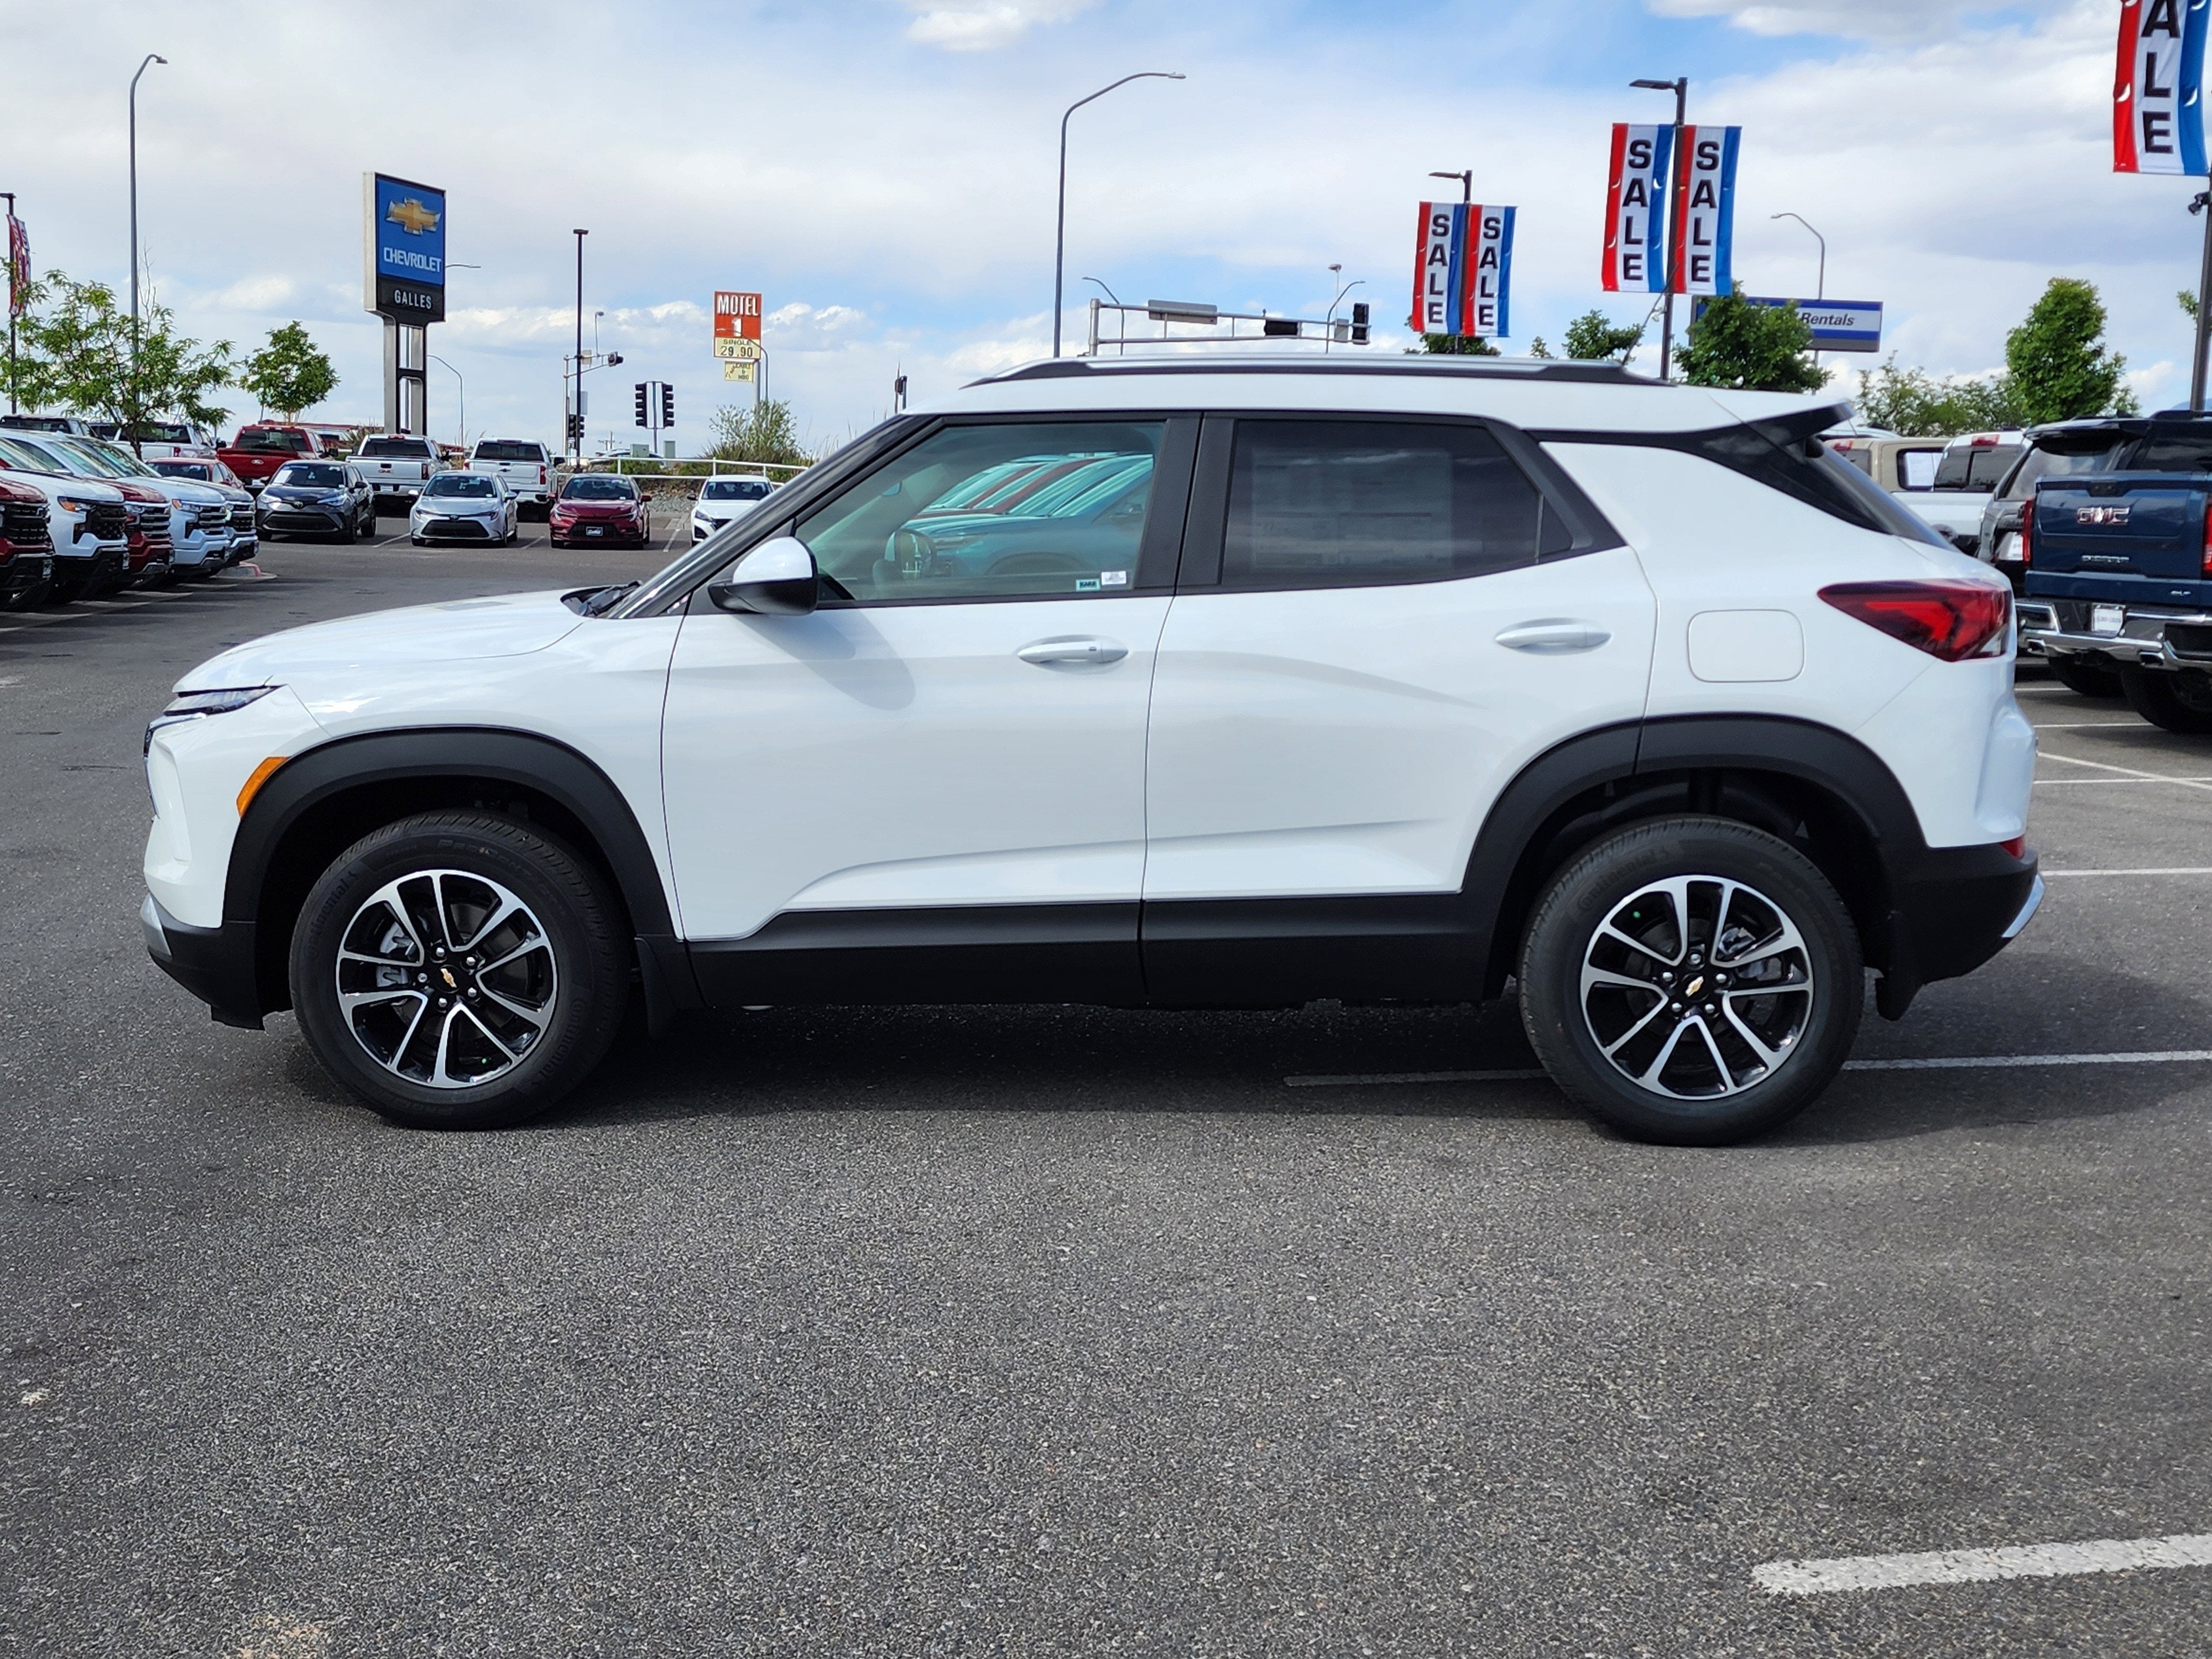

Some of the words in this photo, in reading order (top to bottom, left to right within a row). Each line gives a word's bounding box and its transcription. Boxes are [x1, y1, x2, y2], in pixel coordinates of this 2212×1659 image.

[1622, 139, 1652, 280] SALE
[1690, 140, 1720, 283] SALE
[383, 247, 442, 273] CHEVROLET
[1427, 213, 1451, 324] SALE
[1479, 216, 1501, 326] SALE
[394, 289, 432, 310] GALLES
[717, 294, 760, 316] MOTEL
[732, 317, 742, 337] 1
[1801, 312, 1855, 326] Rentals
[2077, 507, 2130, 525] GMC
